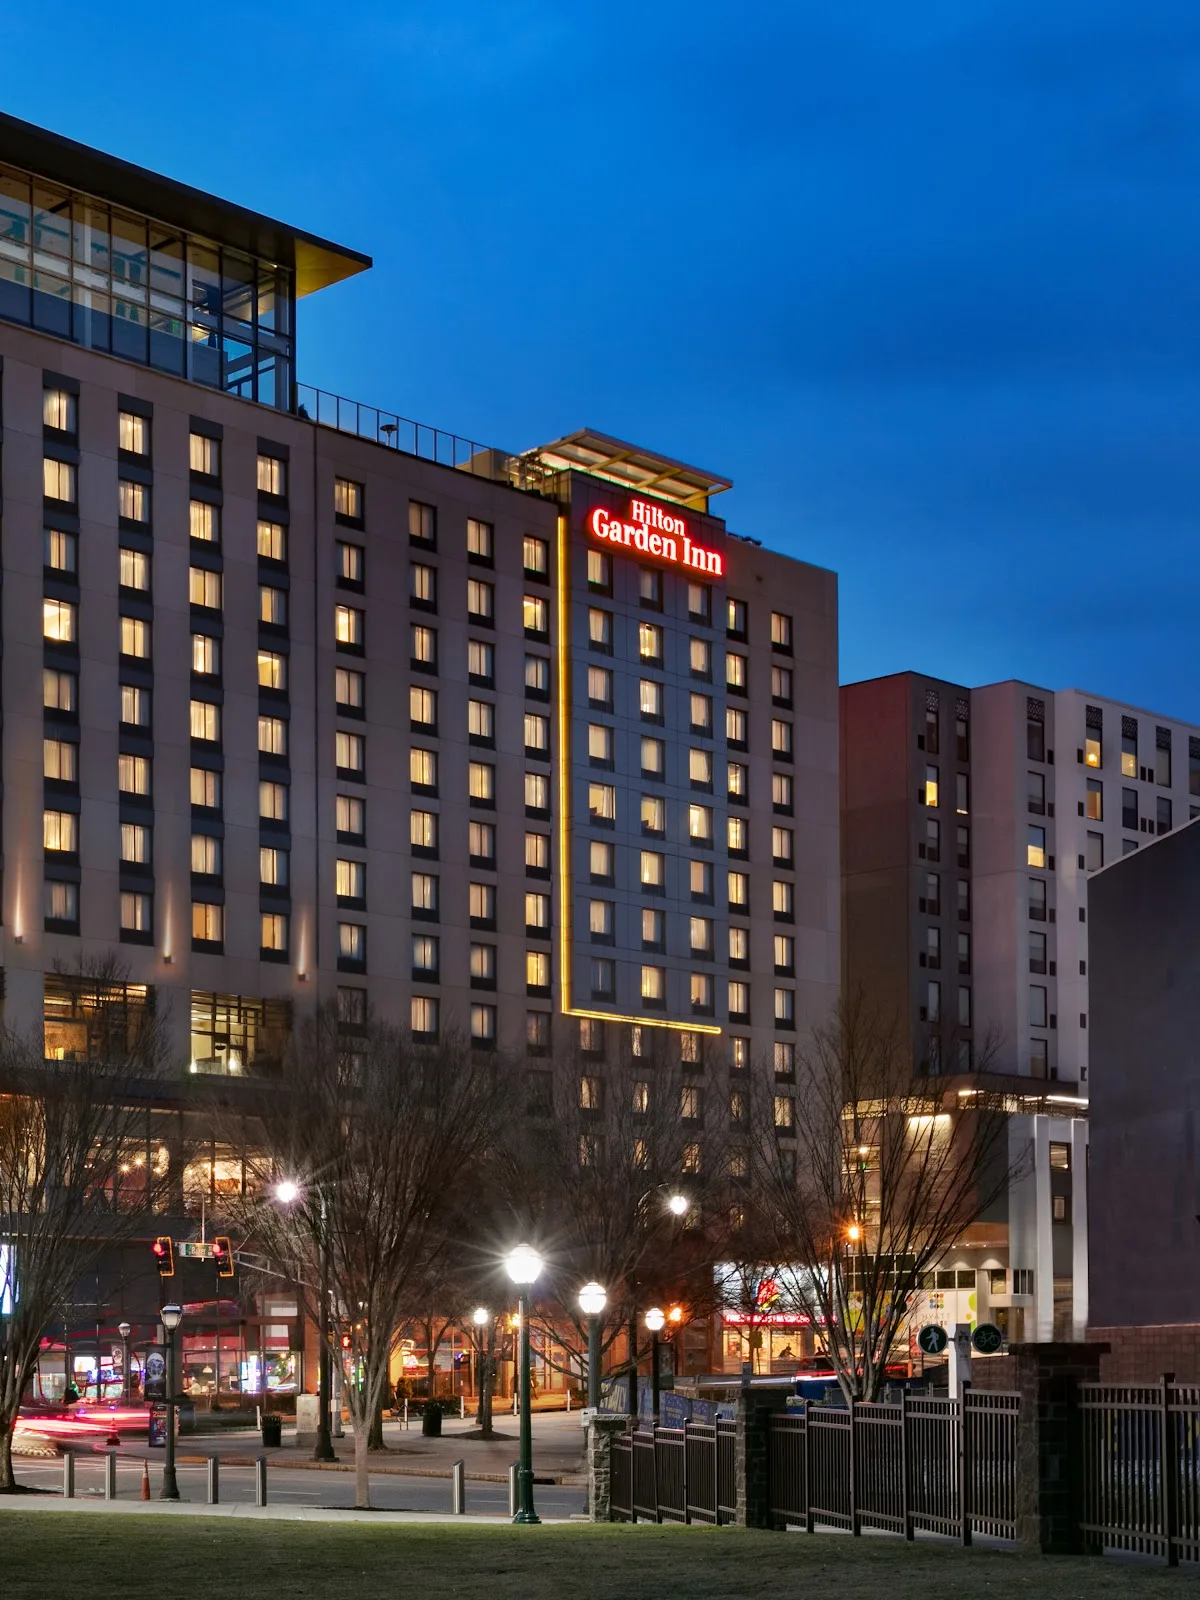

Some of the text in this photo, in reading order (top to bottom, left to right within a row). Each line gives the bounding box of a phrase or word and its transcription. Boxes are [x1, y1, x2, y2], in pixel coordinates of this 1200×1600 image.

[631, 499, 686, 537] Hilton
[591, 508, 723, 576] Garden Inn
[191, 1246, 206, 1256] Baker
[921, 1312, 952, 1320] HYATT
